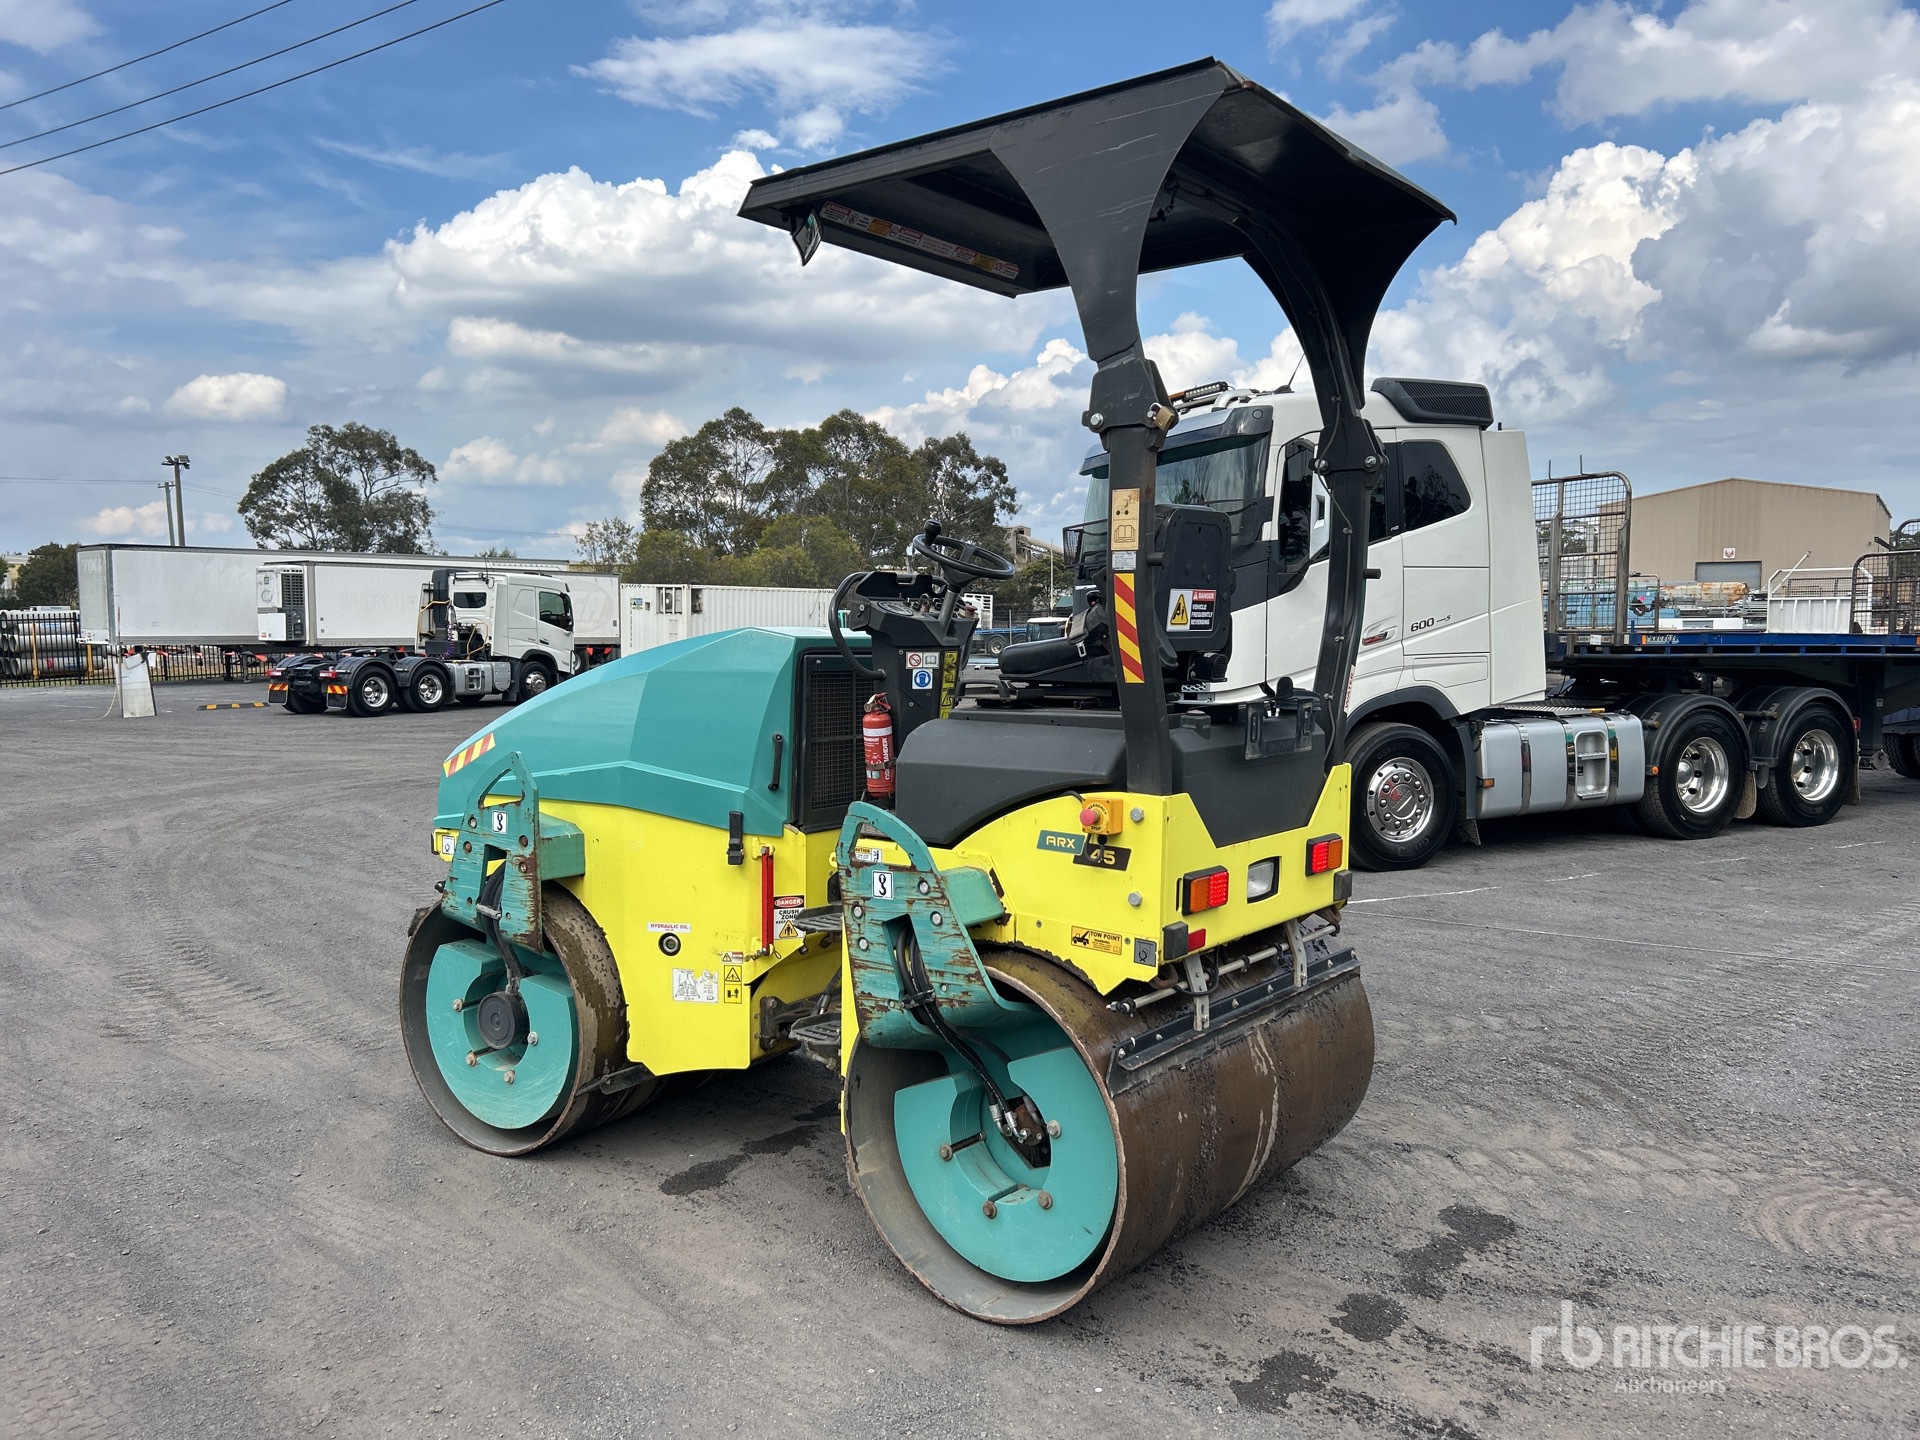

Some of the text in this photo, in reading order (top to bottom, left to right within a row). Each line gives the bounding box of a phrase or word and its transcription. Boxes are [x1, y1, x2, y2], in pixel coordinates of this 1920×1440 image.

[1411, 617, 1434, 632] 600
[882, 737, 891, 780] COANDER
[1046, 835, 1076, 849] ARX
[1090, 849, 1116, 866] 45
[1103, 933, 1121, 942] POINT
